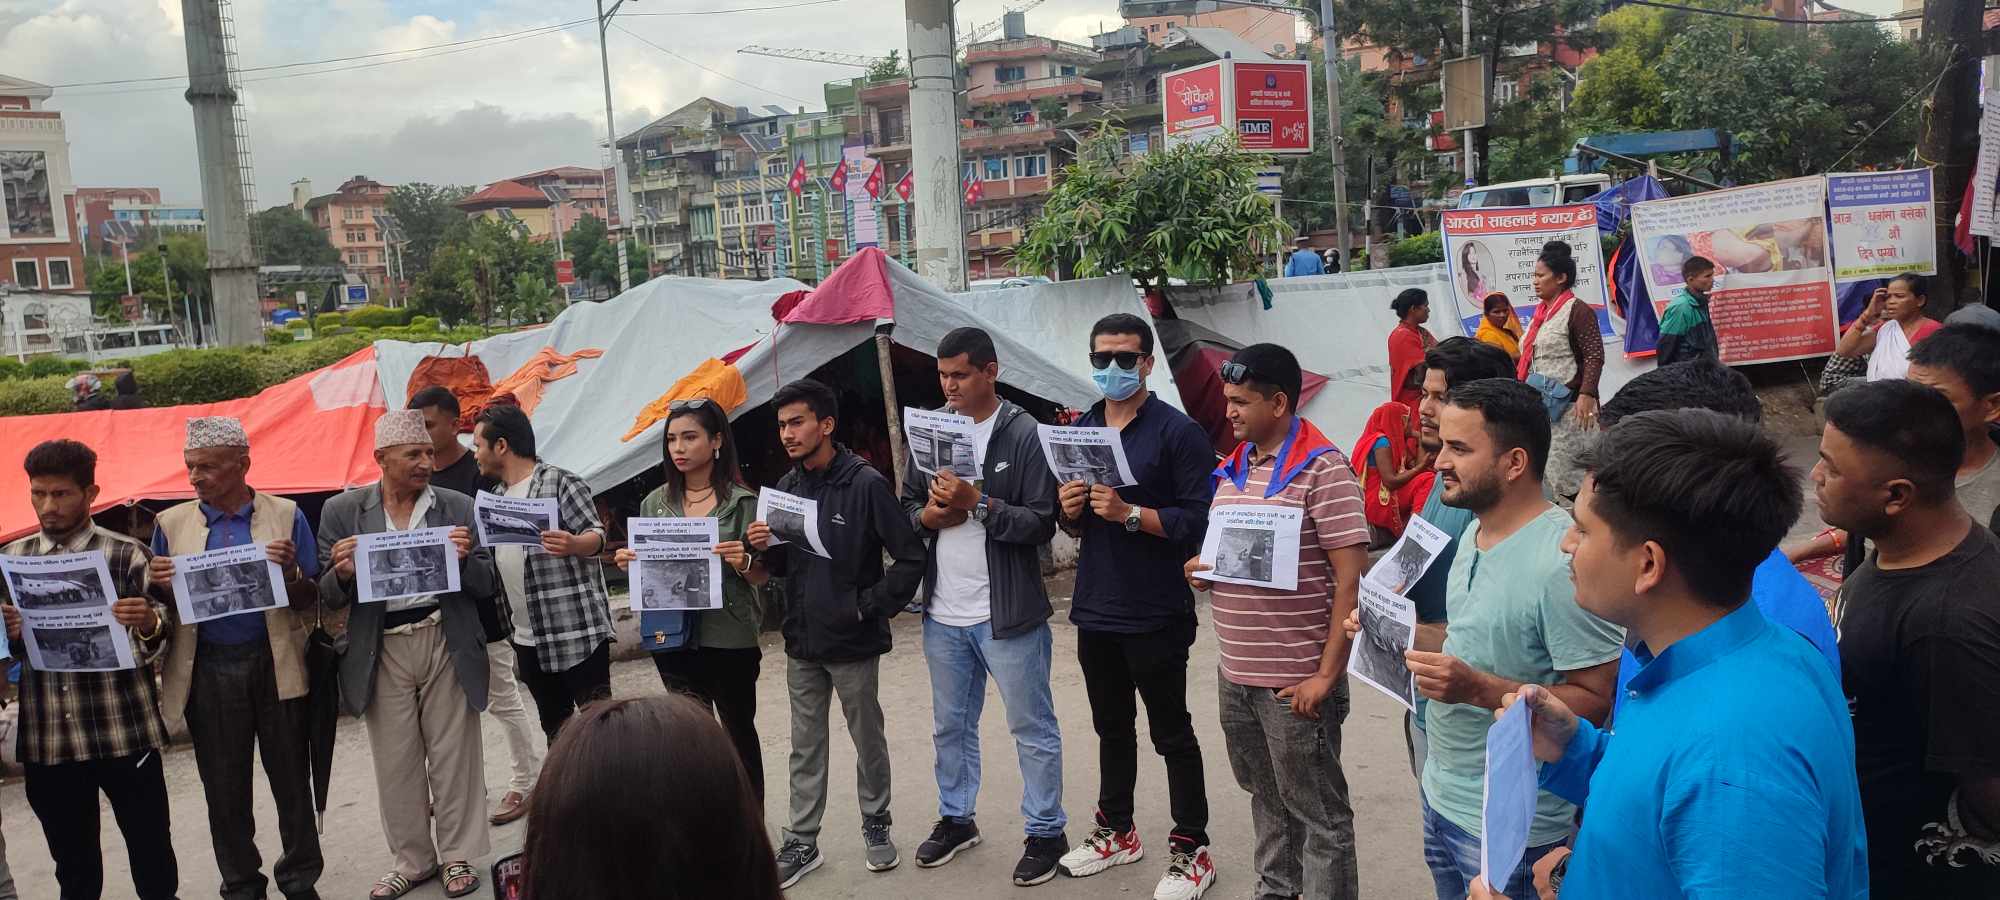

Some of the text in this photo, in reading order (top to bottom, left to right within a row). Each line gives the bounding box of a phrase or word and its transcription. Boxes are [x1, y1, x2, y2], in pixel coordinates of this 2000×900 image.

[1245, 122, 1270, 134] IME
[1446, 214, 1483, 229] आरती
[1542, 212, 1573, 224] न्याय
